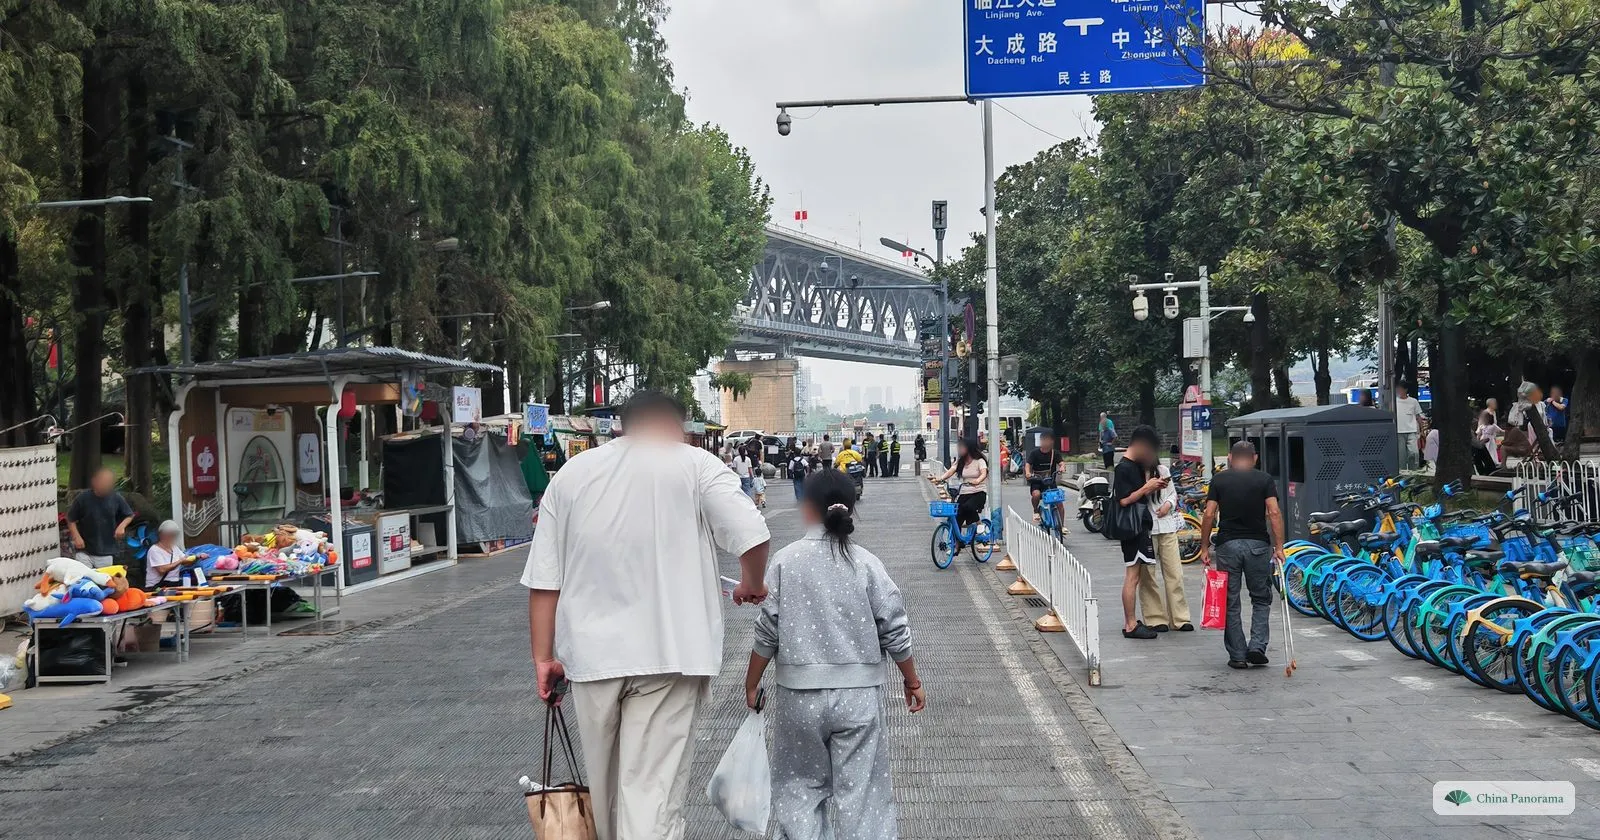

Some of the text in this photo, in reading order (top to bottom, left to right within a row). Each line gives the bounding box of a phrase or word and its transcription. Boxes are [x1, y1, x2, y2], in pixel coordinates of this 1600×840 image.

[1122, 4, 1158, 12] Linjiang
[985, 9, 1045, 19] Linjiang Ave.
[975, 32, 1058, 55] 大成路
[988, 55, 1045, 65] Dacheng Rd.
[1058, 69, 1112, 86] 民主路
